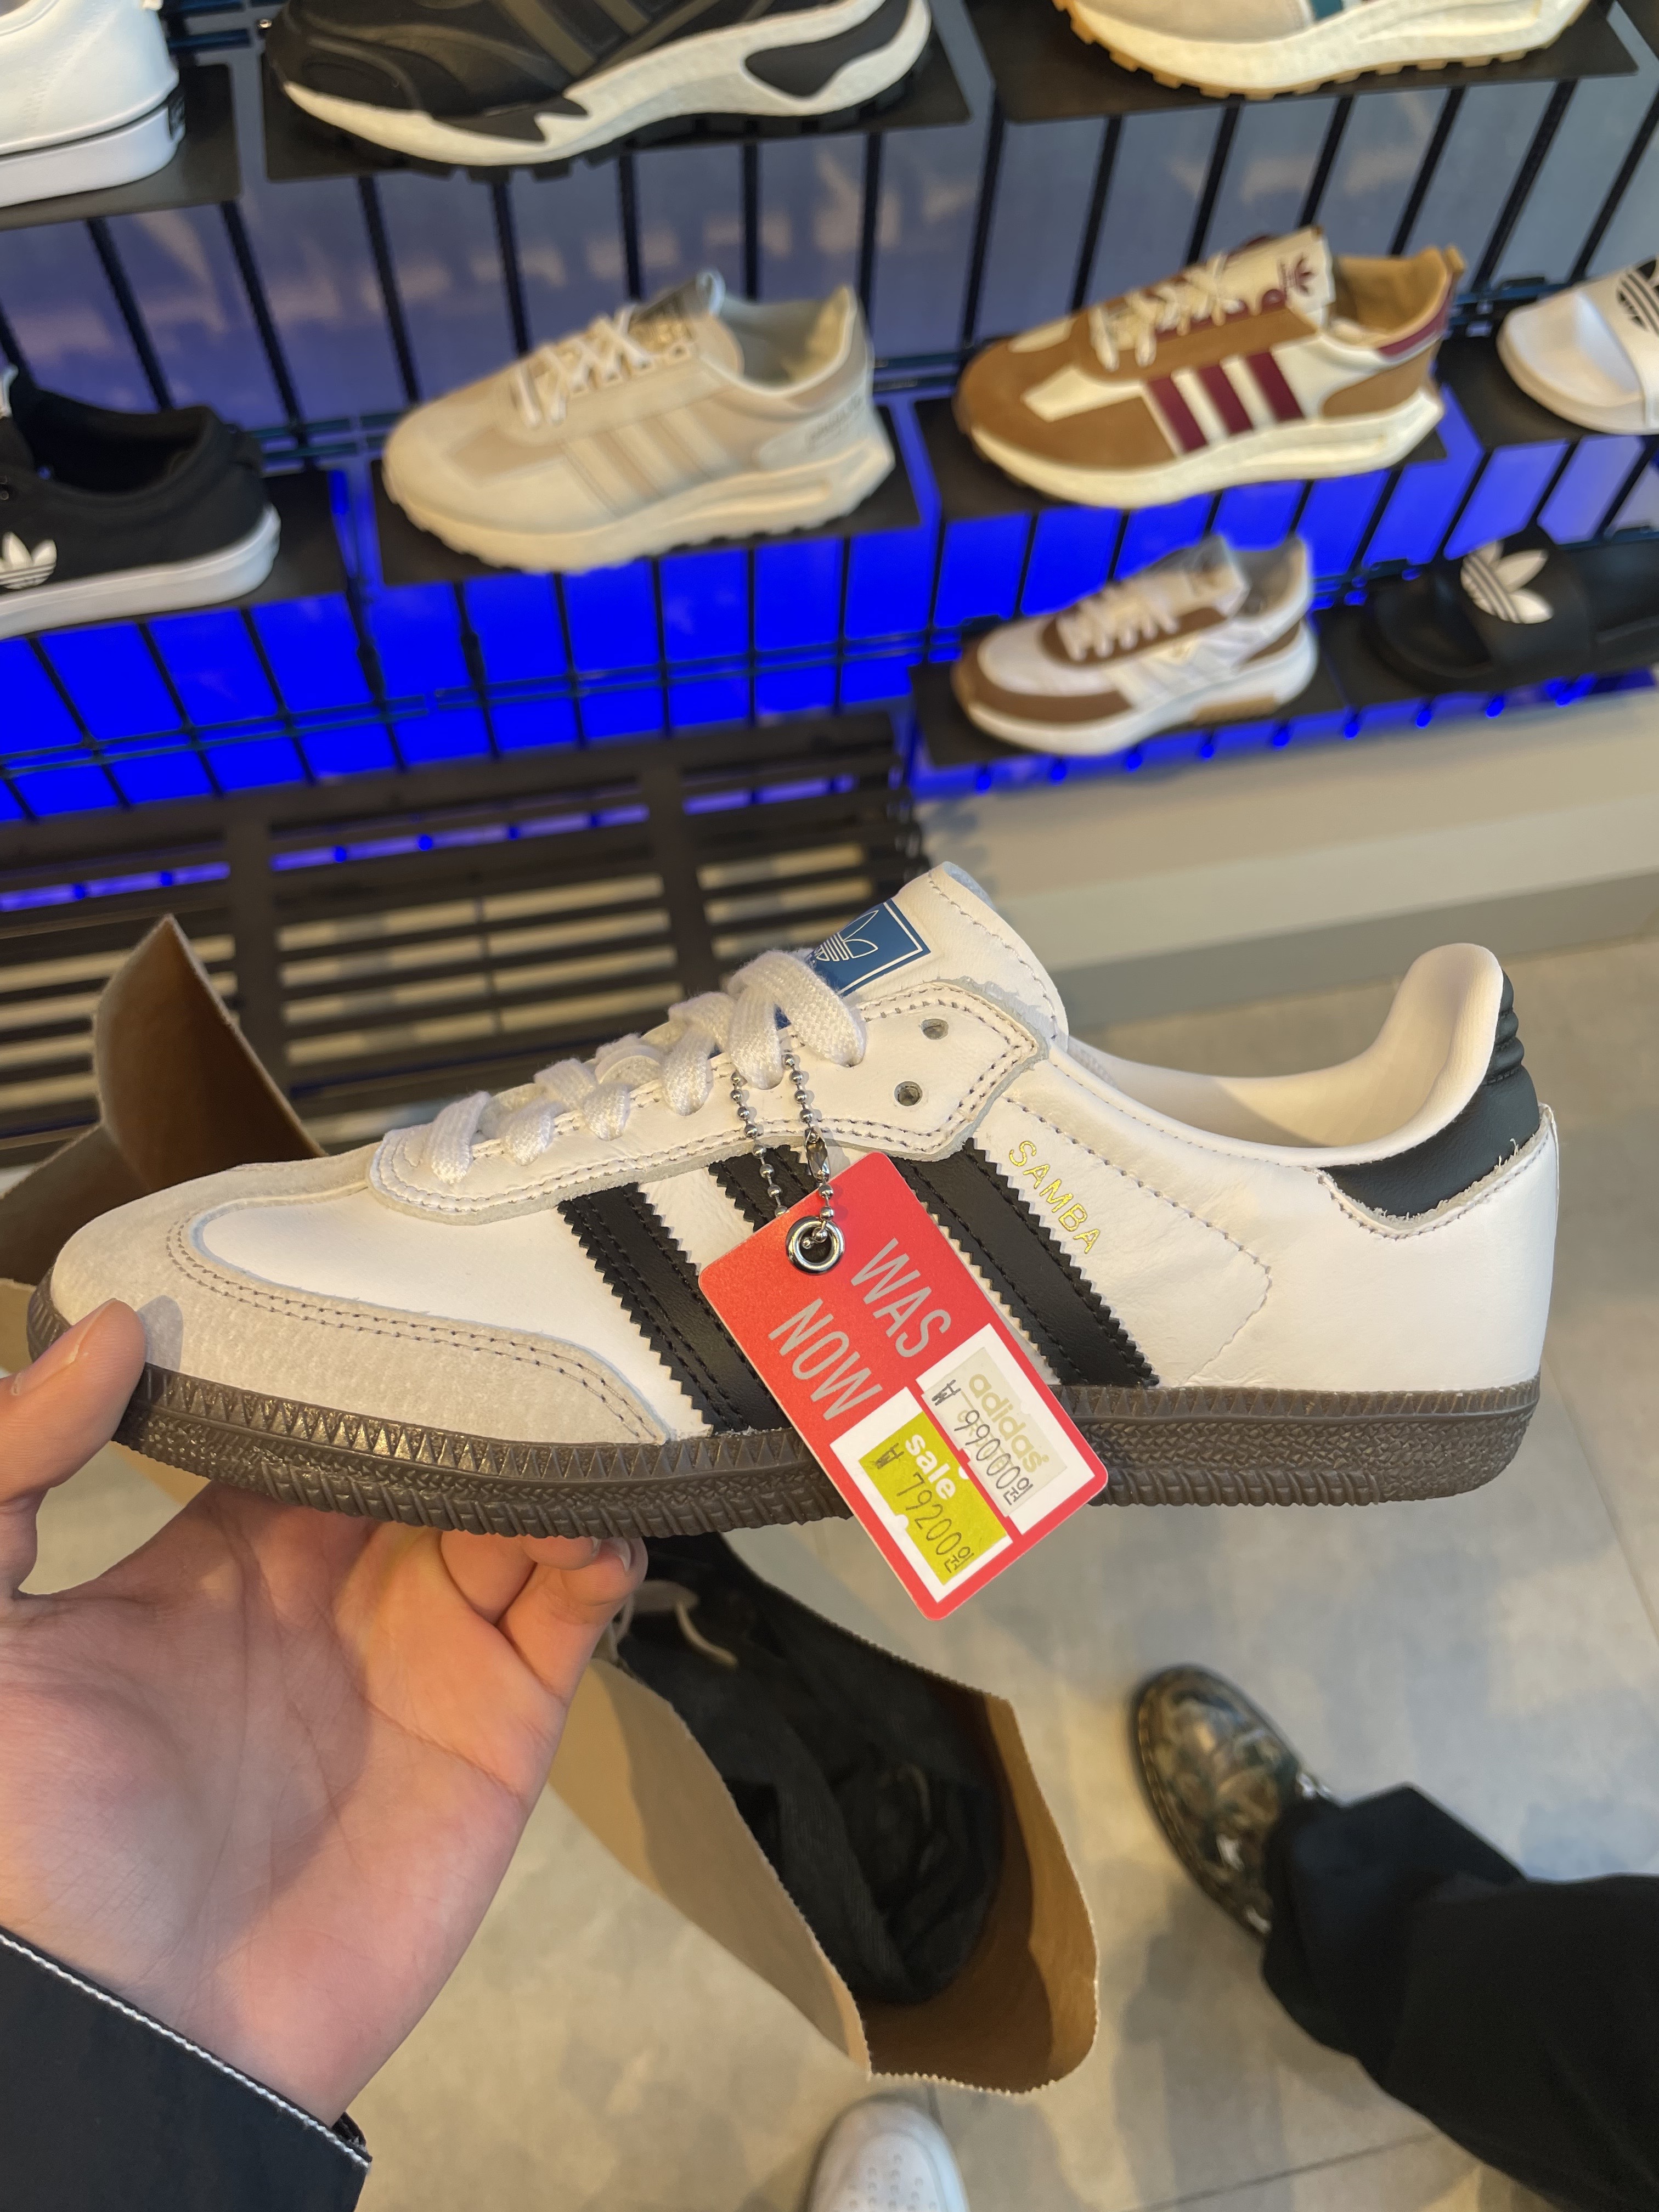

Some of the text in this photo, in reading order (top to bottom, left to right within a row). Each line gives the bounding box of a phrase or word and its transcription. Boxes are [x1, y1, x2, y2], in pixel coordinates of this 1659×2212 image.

[1009, 1141, 1101, 1254] SAMBA
[851, 1238, 951, 1358] WAS
[769, 1299, 883, 1421] NOW
[905, 1434, 956, 1500] sale
